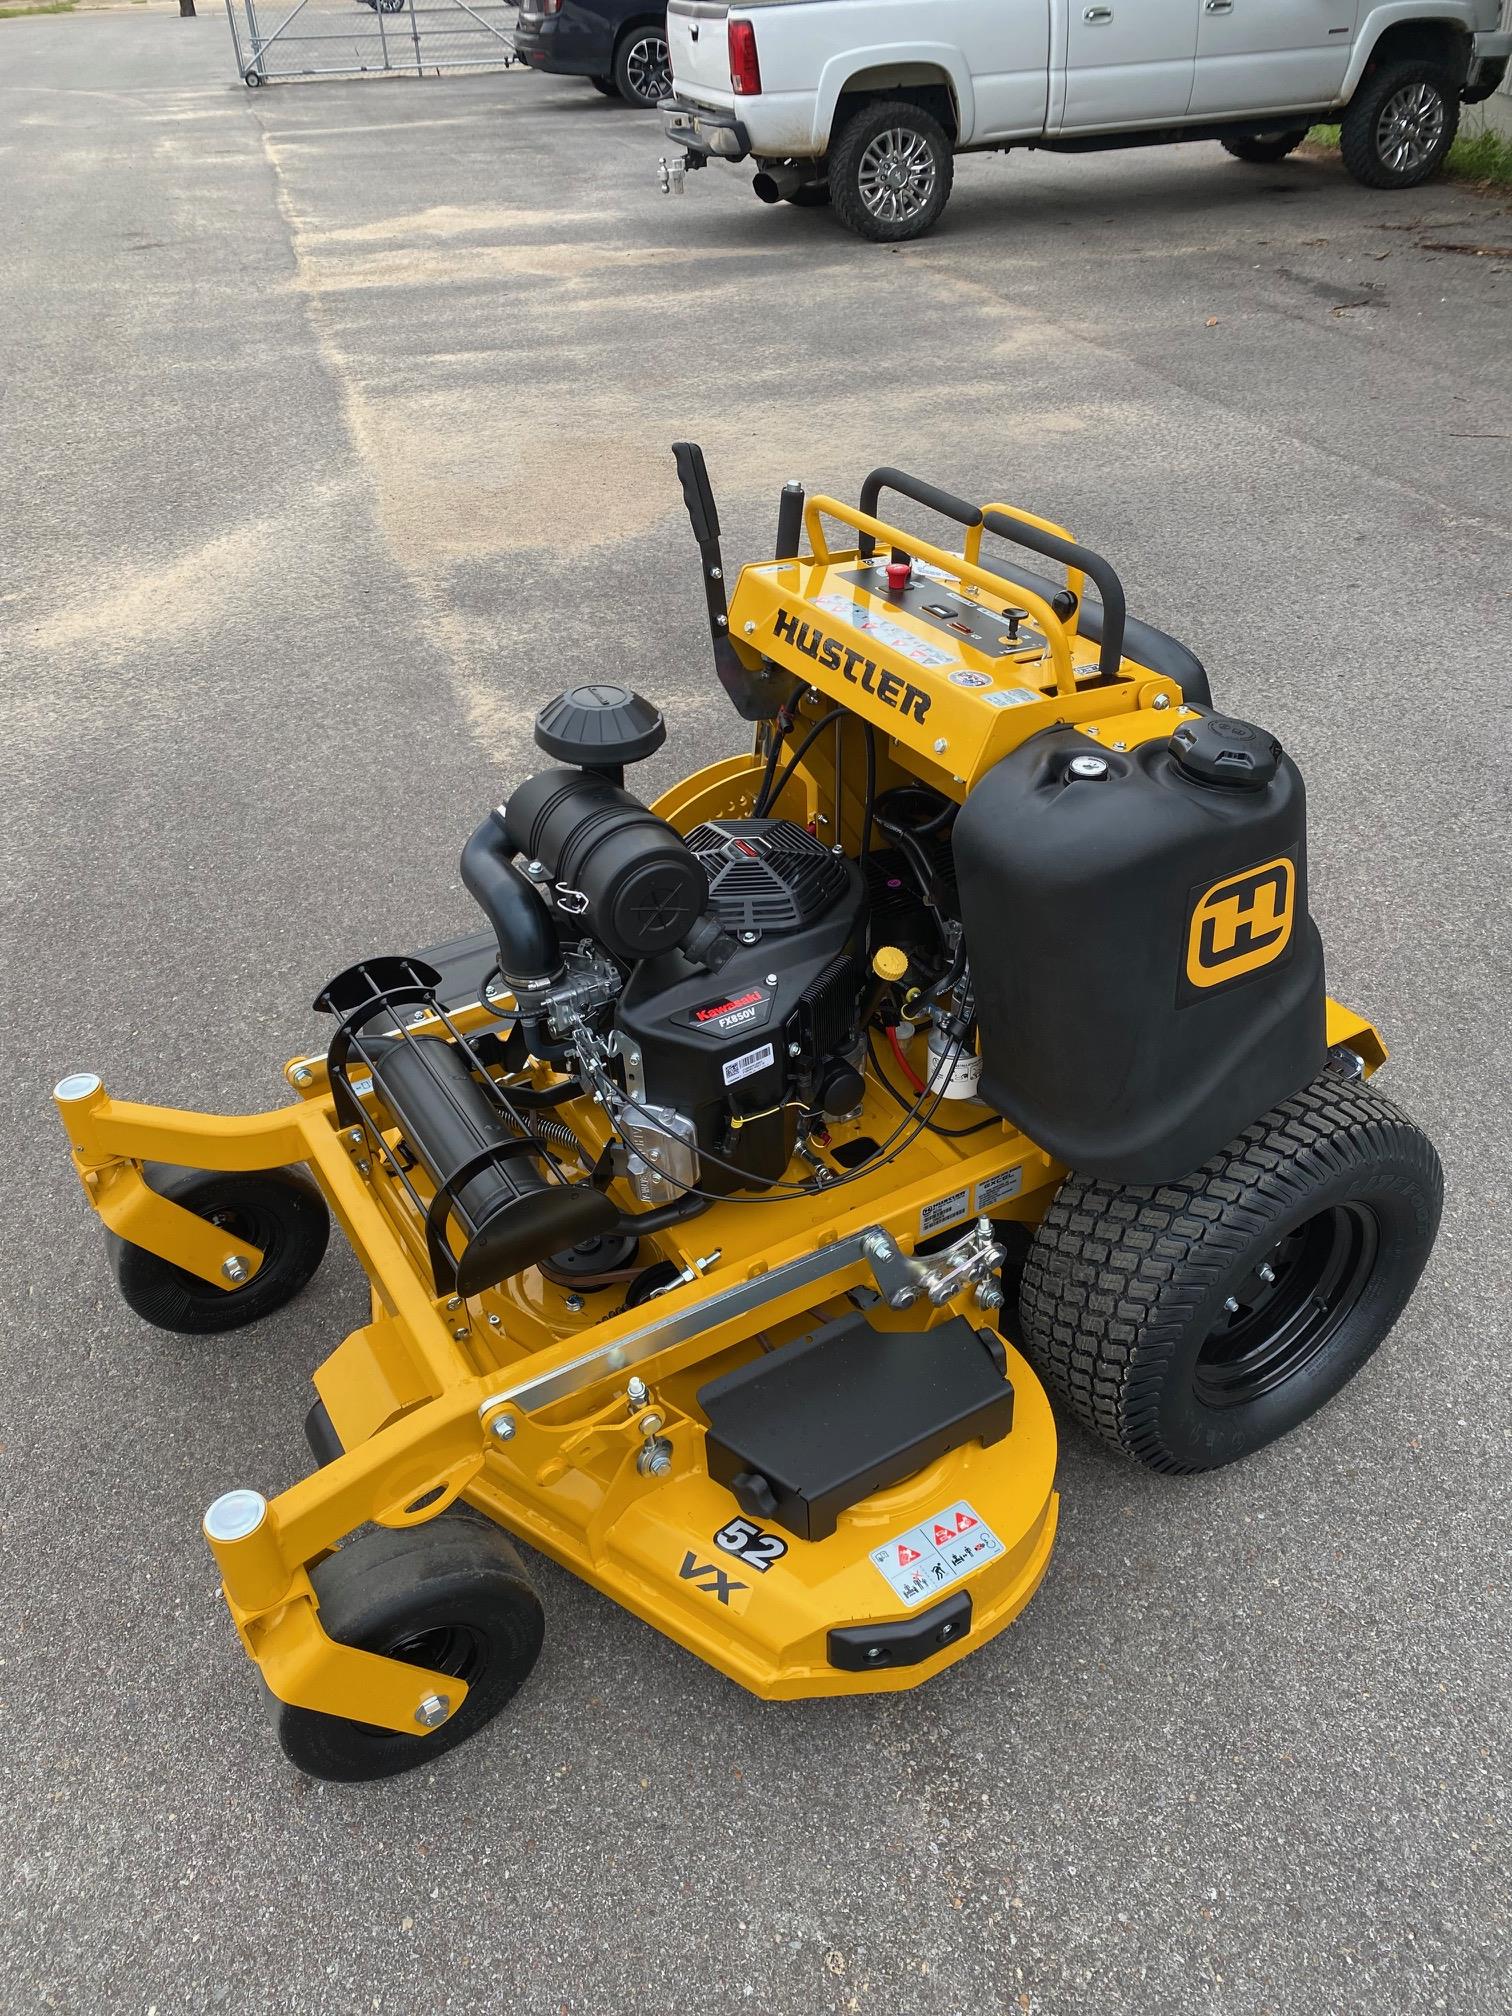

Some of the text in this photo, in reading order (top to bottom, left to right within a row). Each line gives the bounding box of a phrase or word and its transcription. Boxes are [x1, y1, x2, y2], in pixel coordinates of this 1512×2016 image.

[773, 608, 931, 725] HUSTLER
[696, 991, 762, 1021] Kawasaki
[719, 1007, 756, 1028] FX850V
[716, 1518, 786, 1571] 52
[679, 1551, 750, 1607] VX
